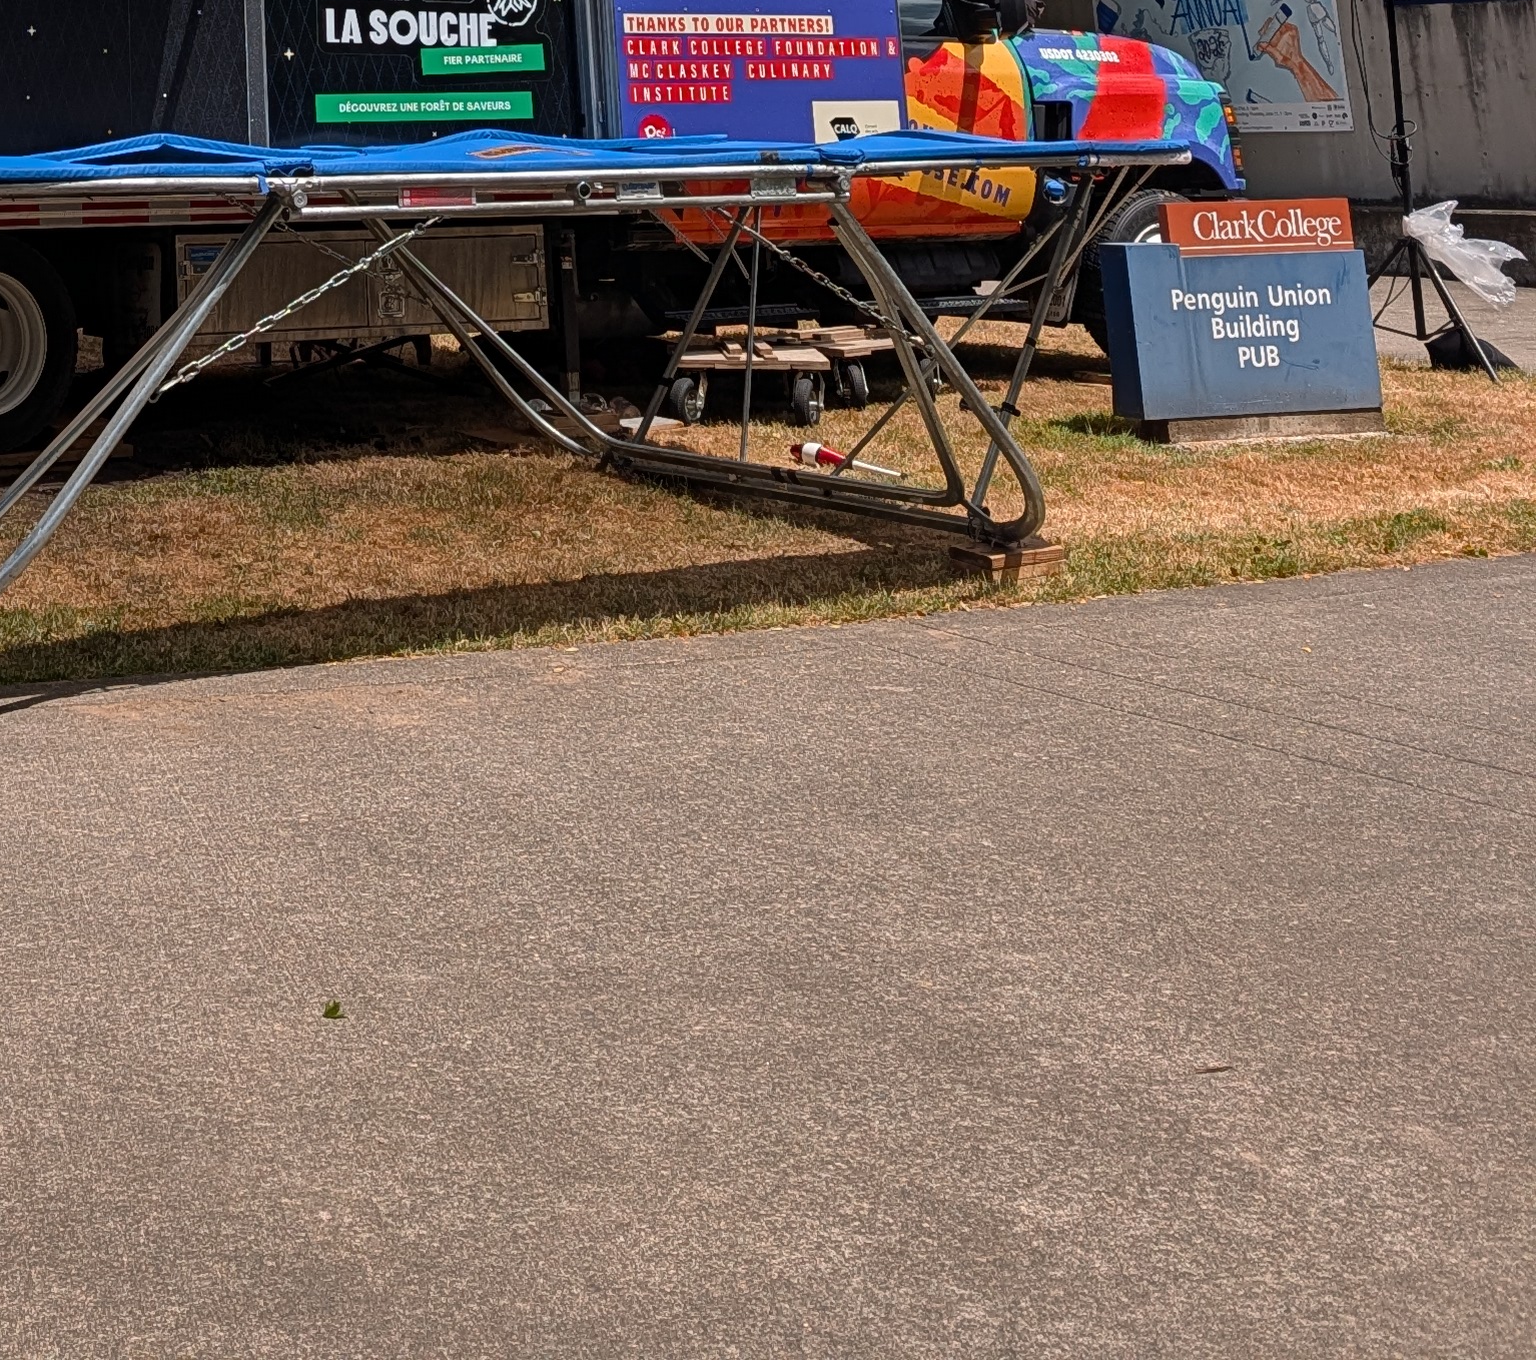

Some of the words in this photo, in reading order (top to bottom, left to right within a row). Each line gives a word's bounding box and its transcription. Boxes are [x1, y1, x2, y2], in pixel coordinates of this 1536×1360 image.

[325, 8, 363, 44] LA
[369, 9, 498, 47] SOUCHE
[627, 16, 686, 32] THANKS
[692, 17, 708, 32] TO
[716, 17, 744, 32] OUR
[750, 18, 830, 33] PARTNERS!
[627, 40, 680, 55] CLARK
[690, 40, 764, 55] COLLEGE
[775, 41, 878, 56] FOUNDATION
[888, 41, 897, 54] &
[1039, 48, 1073, 61] USDOT
[443, 55, 463, 65] FIER
[465, 54, 522, 65] PARTENAIRE
[748, 63, 831, 78] CULINARY
[633, 86, 729, 101] INSTITUTE
[339, 100, 398, 113] DÉCOUVREZ
[400, 103, 418, 112] UNE
[420, 99, 450, 111] FORÊT
[453, 102, 464, 111] DE
[466, 101, 511, 111] SAVEURS
[834, 124, 858, 134] CALQ
[1171, 285, 1259, 315] Penguin
[1267, 283, 1332, 307] Union
[1211, 315, 1300, 342] Building
[1238, 346, 1281, 369] PUB
